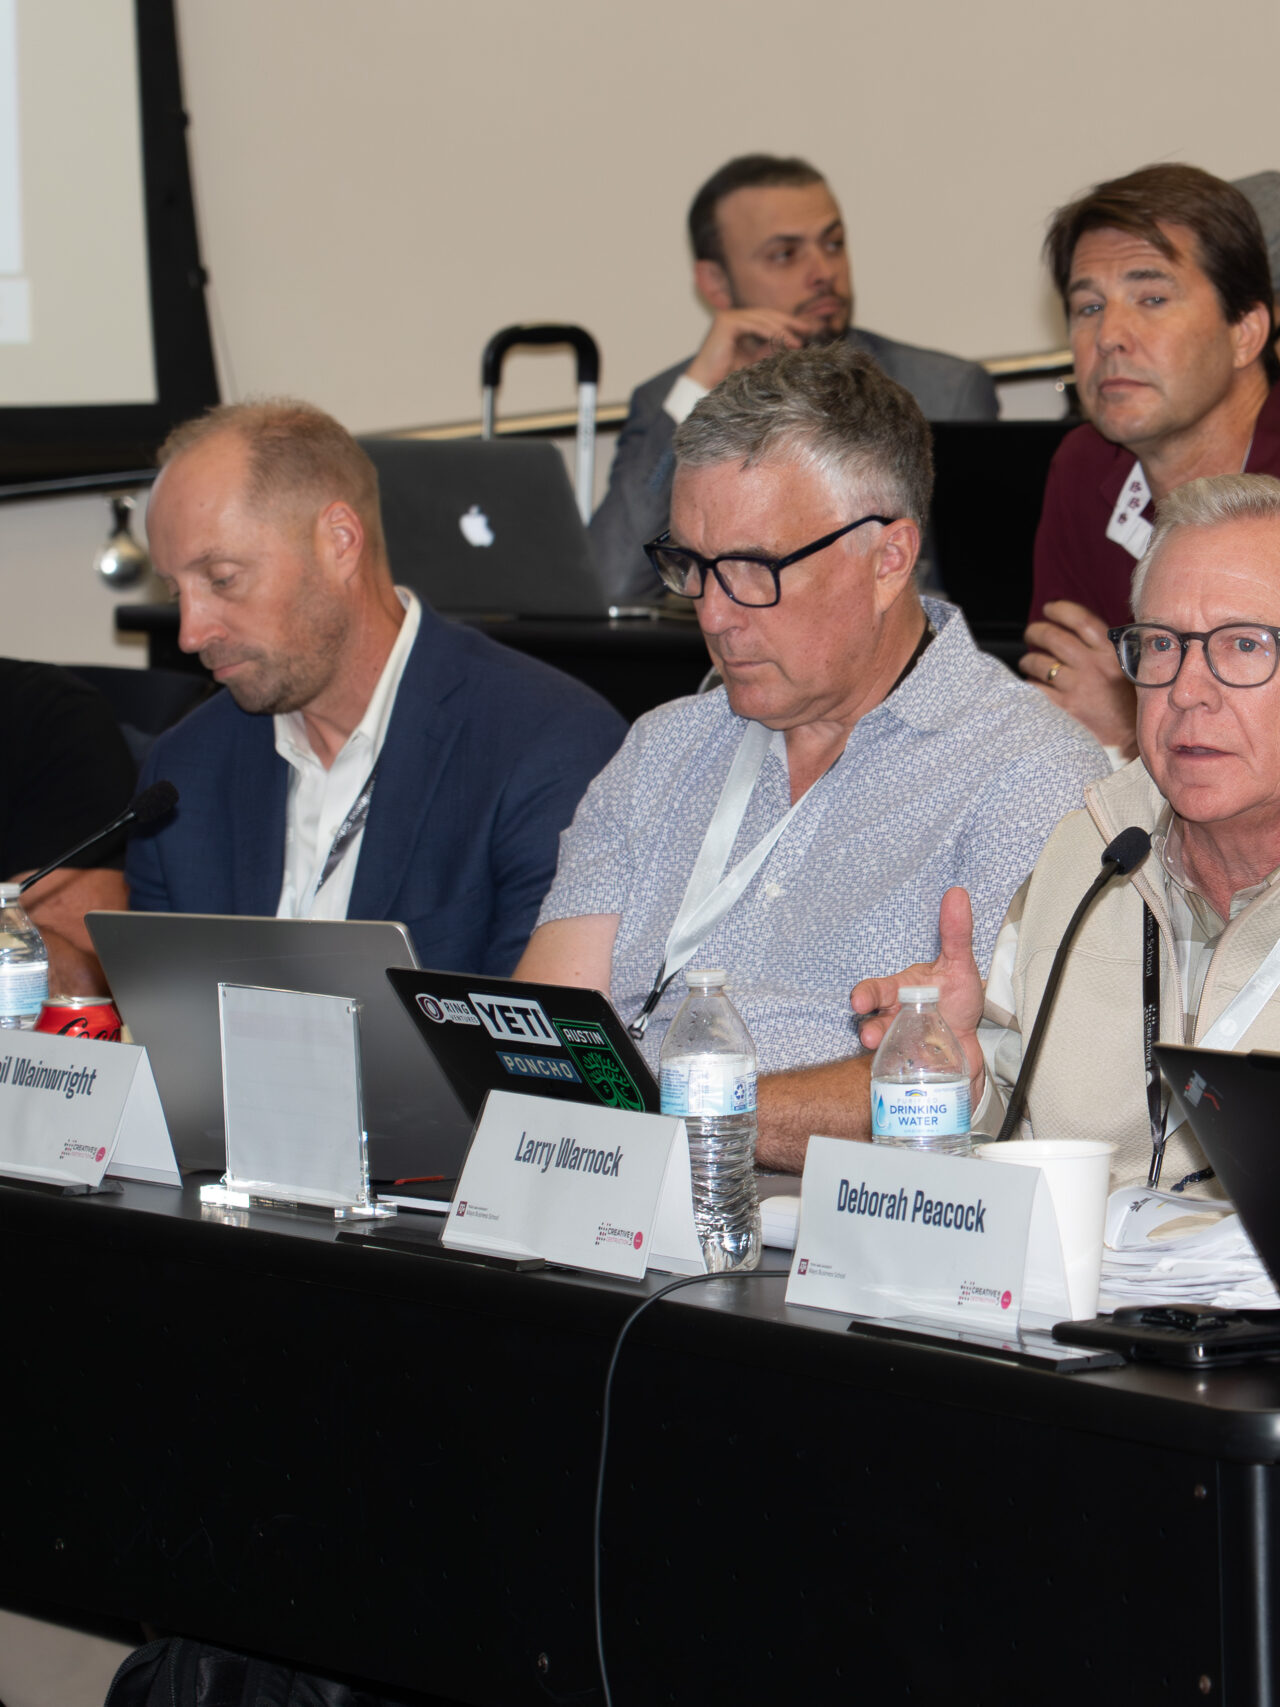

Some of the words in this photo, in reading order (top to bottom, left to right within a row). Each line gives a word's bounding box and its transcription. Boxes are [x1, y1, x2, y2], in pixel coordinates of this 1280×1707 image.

[1145, 938, 1155, 977] School
[444, 1001, 468, 1015] RING
[449, 1014, 479, 1024] VENTURES
[476, 1002, 552, 1039] YETI
[563, 1027, 605, 1045] AUSTIN
[503, 1055, 574, 1079] PONCHO
[11, 1057, 97, 1099] Wainwright
[890, 1104, 947, 1114] DRINKING
[898, 1116, 938, 1126] WATER
[514, 1131, 556, 1173] Larry
[555, 1137, 624, 1177] Warnock
[837, 1179, 908, 1221] Deborah
[911, 1189, 986, 1233] Peacock
[607, 1227, 630, 1238] CREATIVE
